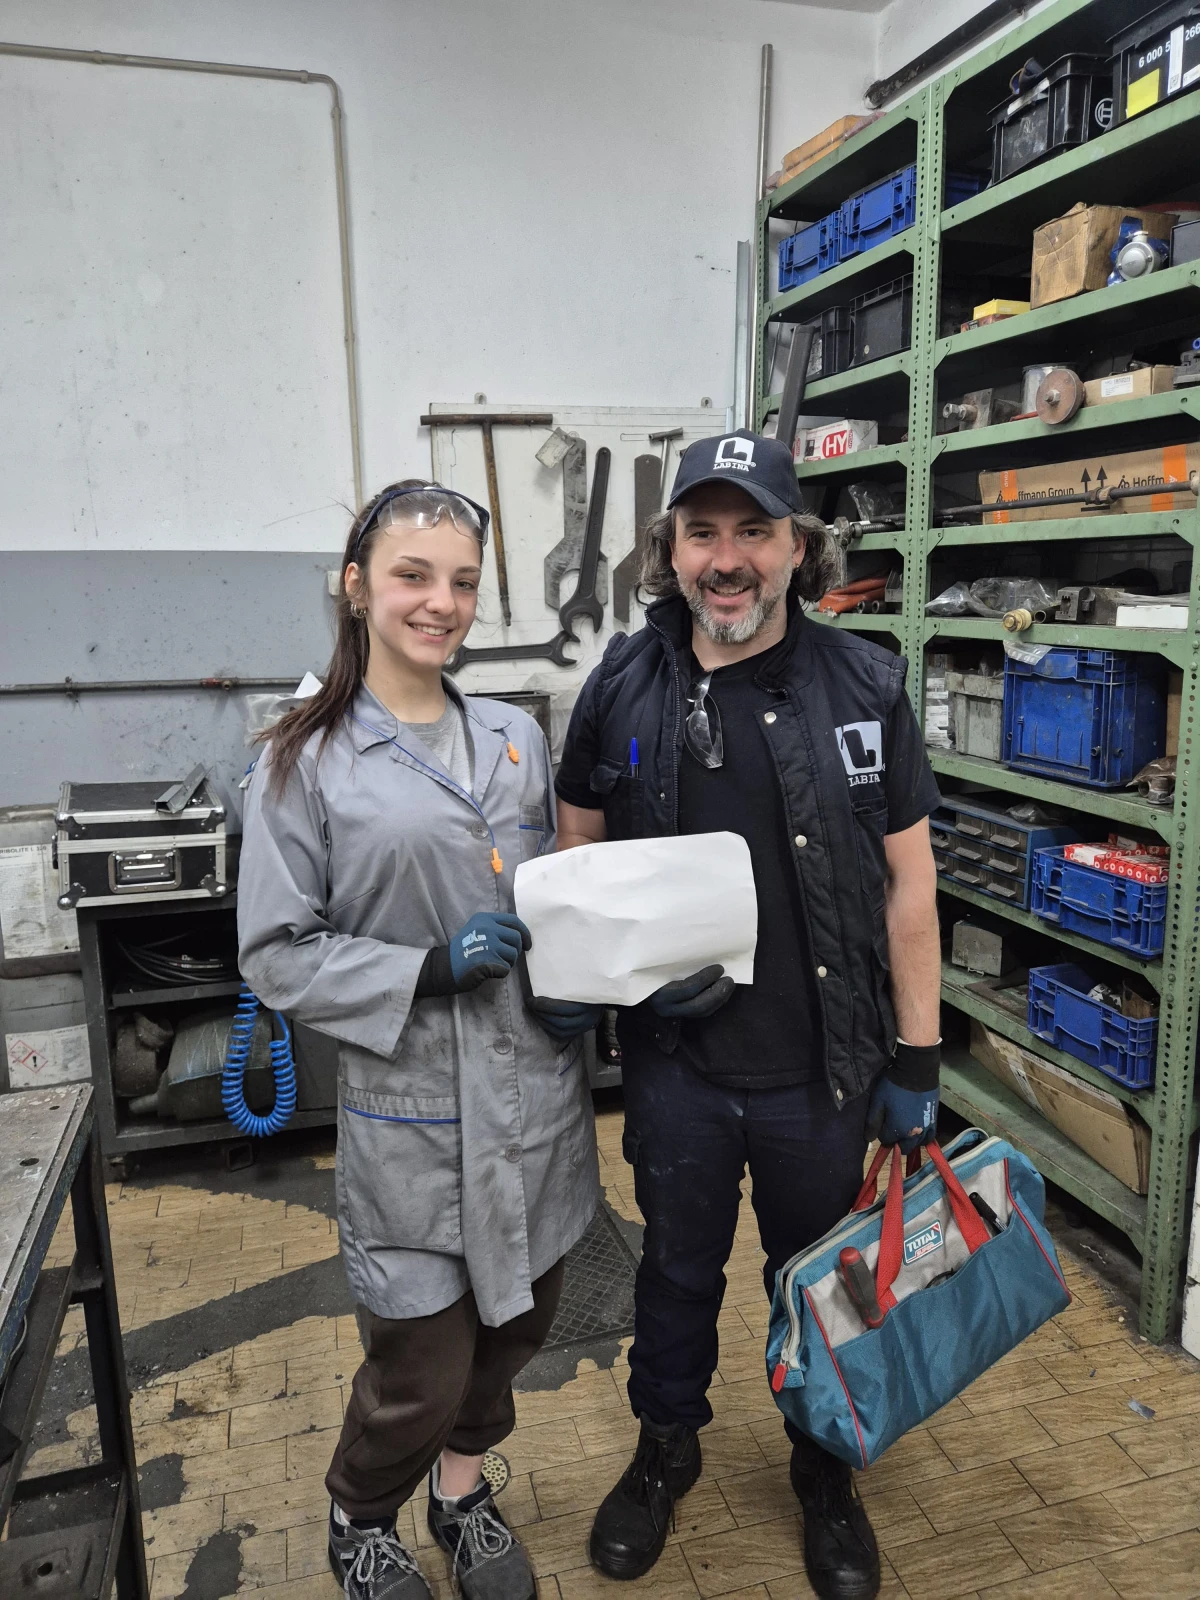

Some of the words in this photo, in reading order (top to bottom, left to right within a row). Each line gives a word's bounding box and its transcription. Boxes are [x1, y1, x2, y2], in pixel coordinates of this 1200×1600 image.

[1138, 56, 1145, 68] 6
[1146, 45, 1163, 63] 000
[713, 462, 749, 472] LABINA
[906, 1230, 938, 1253] TOTAL
